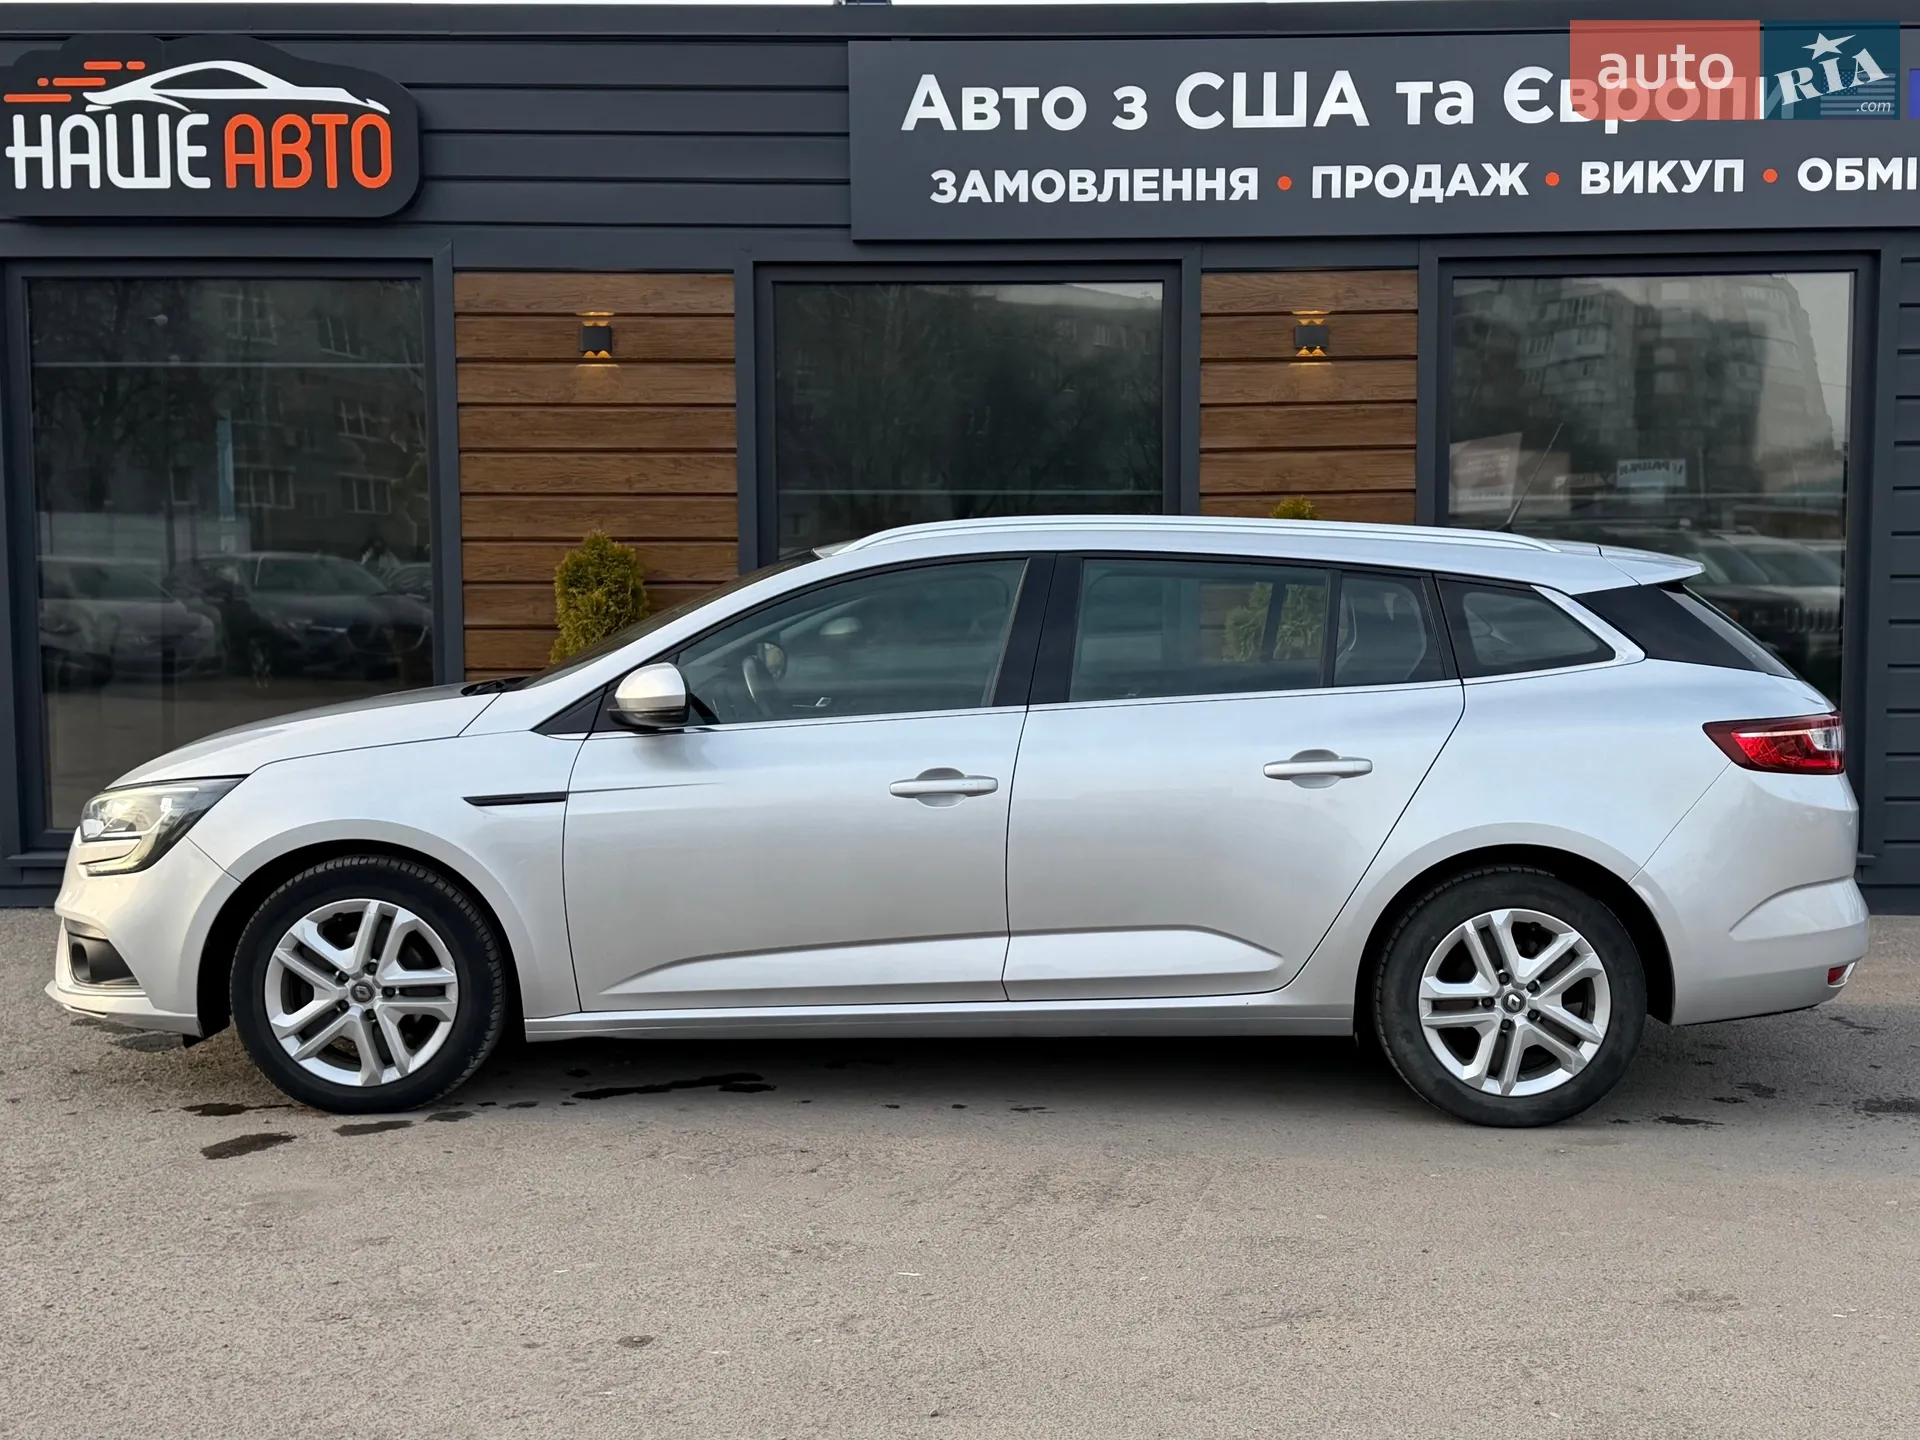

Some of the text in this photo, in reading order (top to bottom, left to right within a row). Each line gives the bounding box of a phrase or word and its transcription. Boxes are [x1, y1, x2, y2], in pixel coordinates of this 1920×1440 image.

[901, 74, 1087, 131] Авто
[1112, 85, 1148, 131] з
[1175, 70, 1370, 130] США
[1394, 80, 1474, 126] та
[5, 113, 393, 190] НАШЕ АВТО
[930, 156, 1919, 204] ЗАМОВЛЕННЯ ПРОДАЖ ВИКУП ОБМІ
